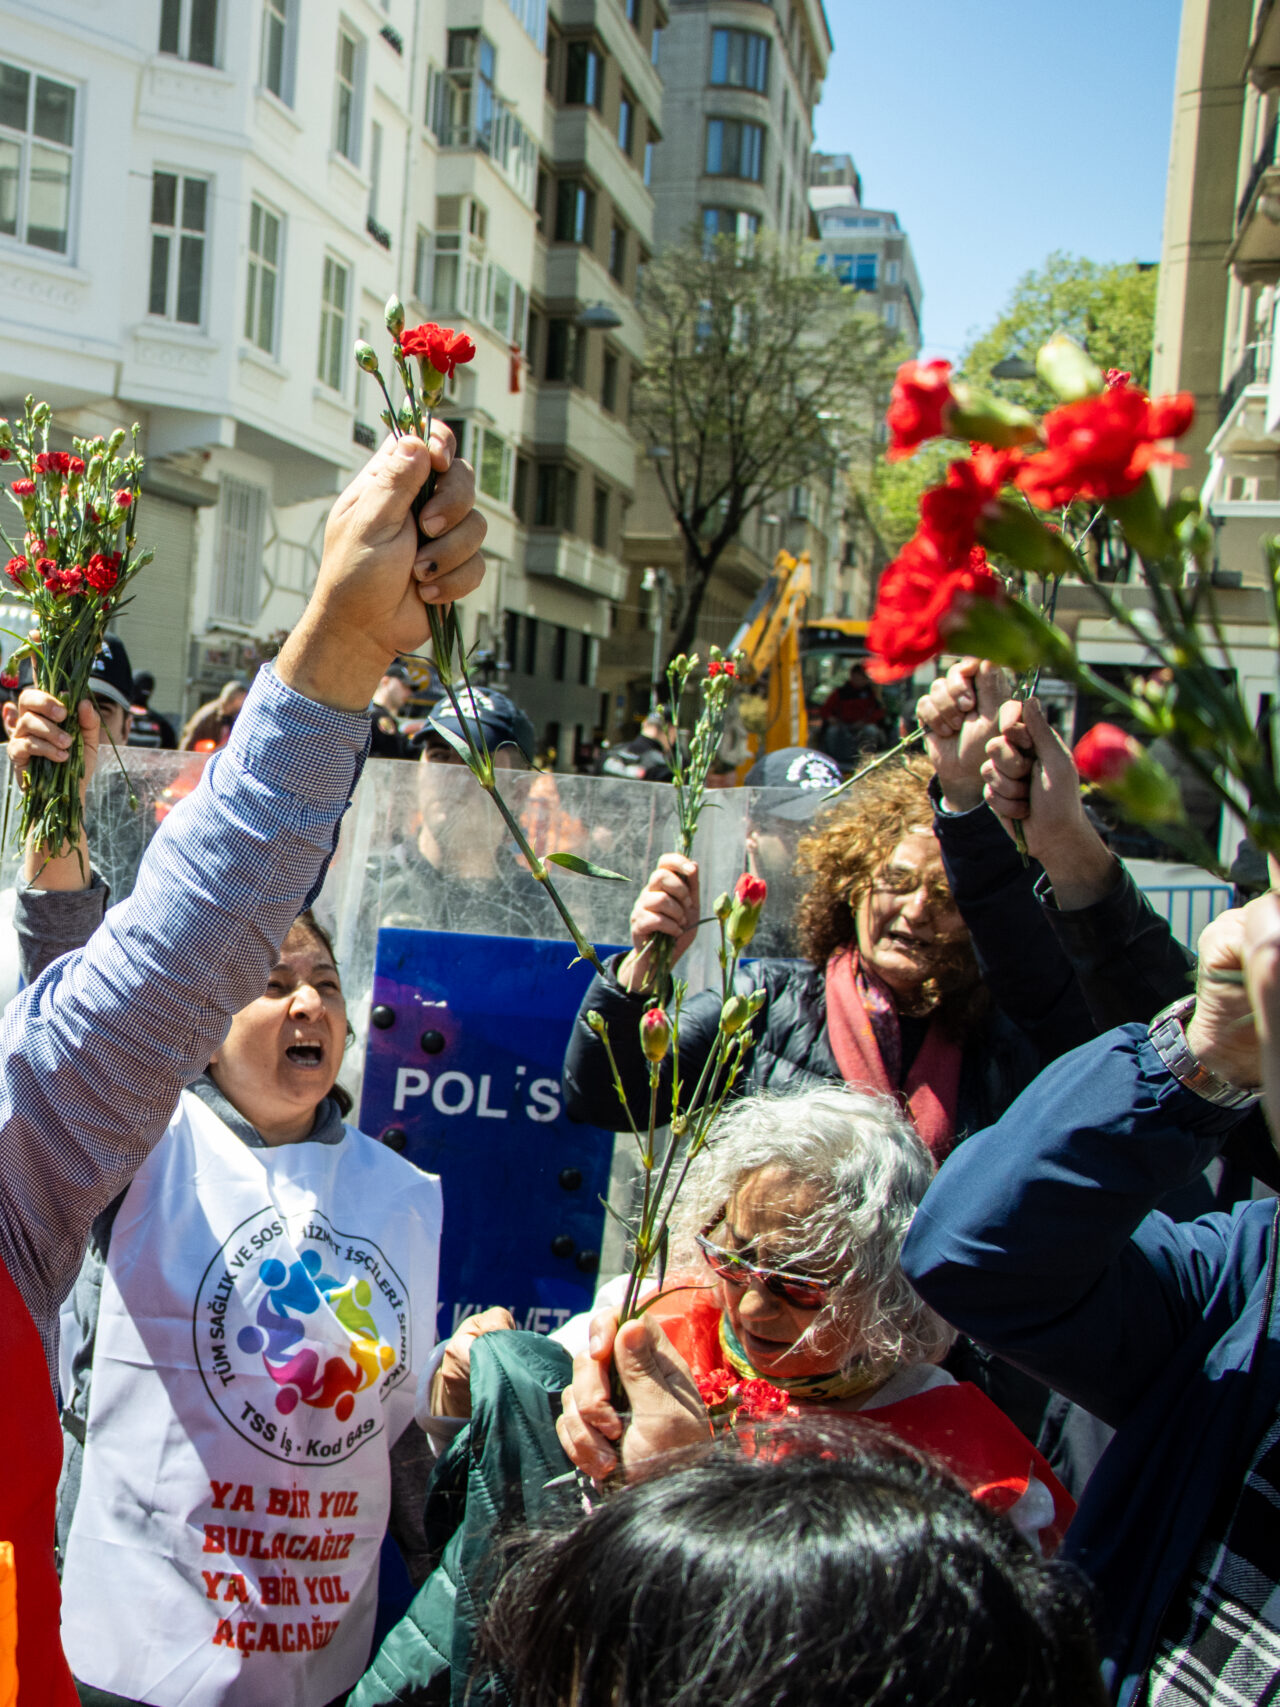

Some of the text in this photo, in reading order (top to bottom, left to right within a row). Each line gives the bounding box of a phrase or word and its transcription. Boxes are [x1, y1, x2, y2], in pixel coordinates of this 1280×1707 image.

[393, 1066, 560, 1122] POLS
[230, 1246, 253, 1269] VE
[344, 1246, 404, 1310] İŞÇİLERİ
[207, 1271, 238, 1340] SAĞLIK
[212, 1344, 236, 1387] TÜM
[240, 1401, 277, 1442] TSS
[306, 1438, 341, 1457] Kod
[346, 1418, 375, 1449] 649
[210, 1480, 359, 1519] YA BİR YOL
[202, 1523, 355, 1562] BULACAĞIZ
[201, 1567, 350, 1606] YA BİR YOL
